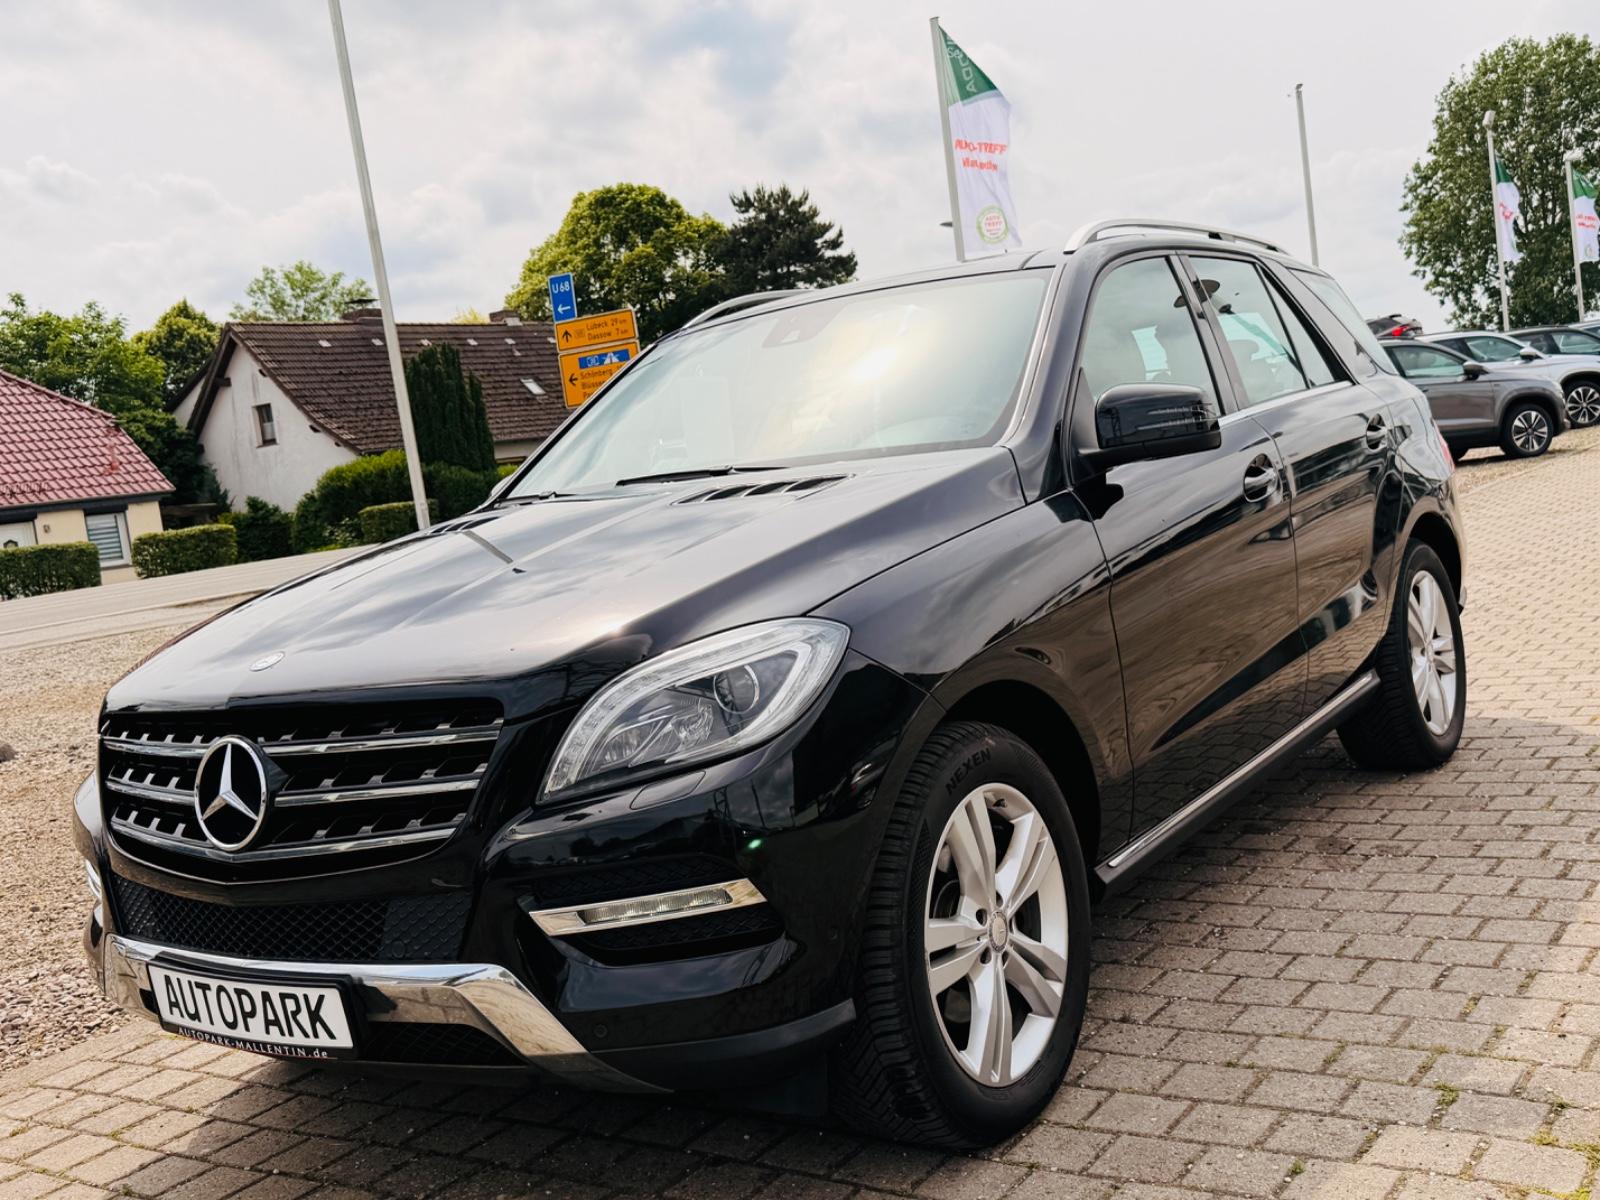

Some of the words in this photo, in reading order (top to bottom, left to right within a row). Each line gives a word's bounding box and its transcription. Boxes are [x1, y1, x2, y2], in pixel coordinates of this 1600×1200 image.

[945, 747, 992, 796] NEXEN
[163, 974, 337, 1040] AUTOPARK
[178, 1027, 329, 1058] AUTOPARK-MALLENTIN.de
